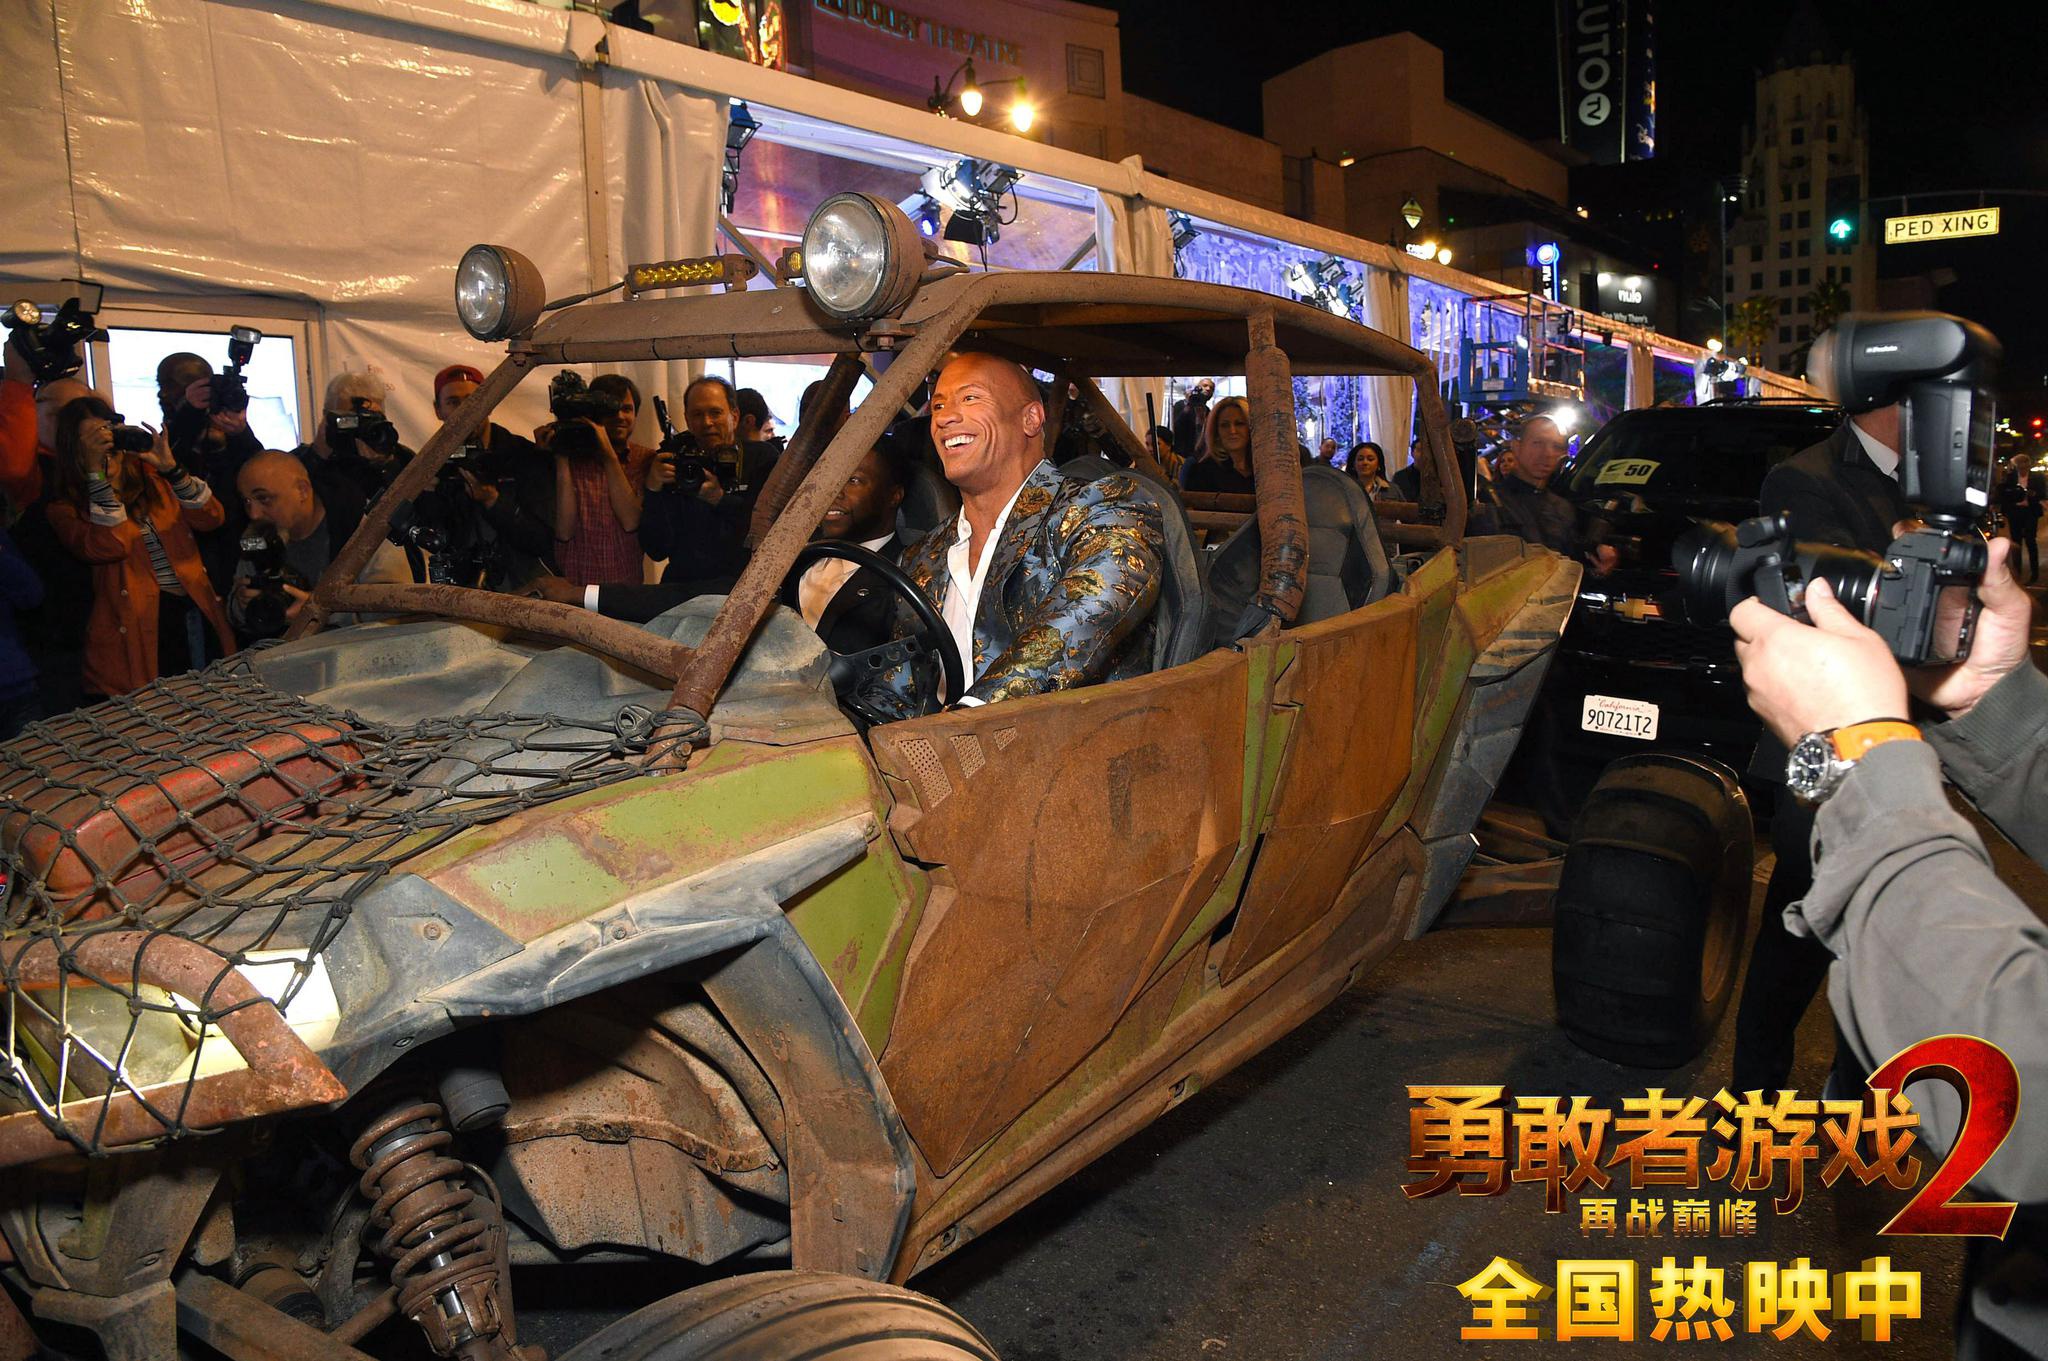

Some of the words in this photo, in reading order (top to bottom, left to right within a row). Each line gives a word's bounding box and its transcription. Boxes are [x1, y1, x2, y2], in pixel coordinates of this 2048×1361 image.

[1895, 220, 1924, 237] PED
[1942, 214, 1989, 233] XING
[1624, 464, 1652, 477] 50
[1587, 708, 1653, 735] 90721T2
